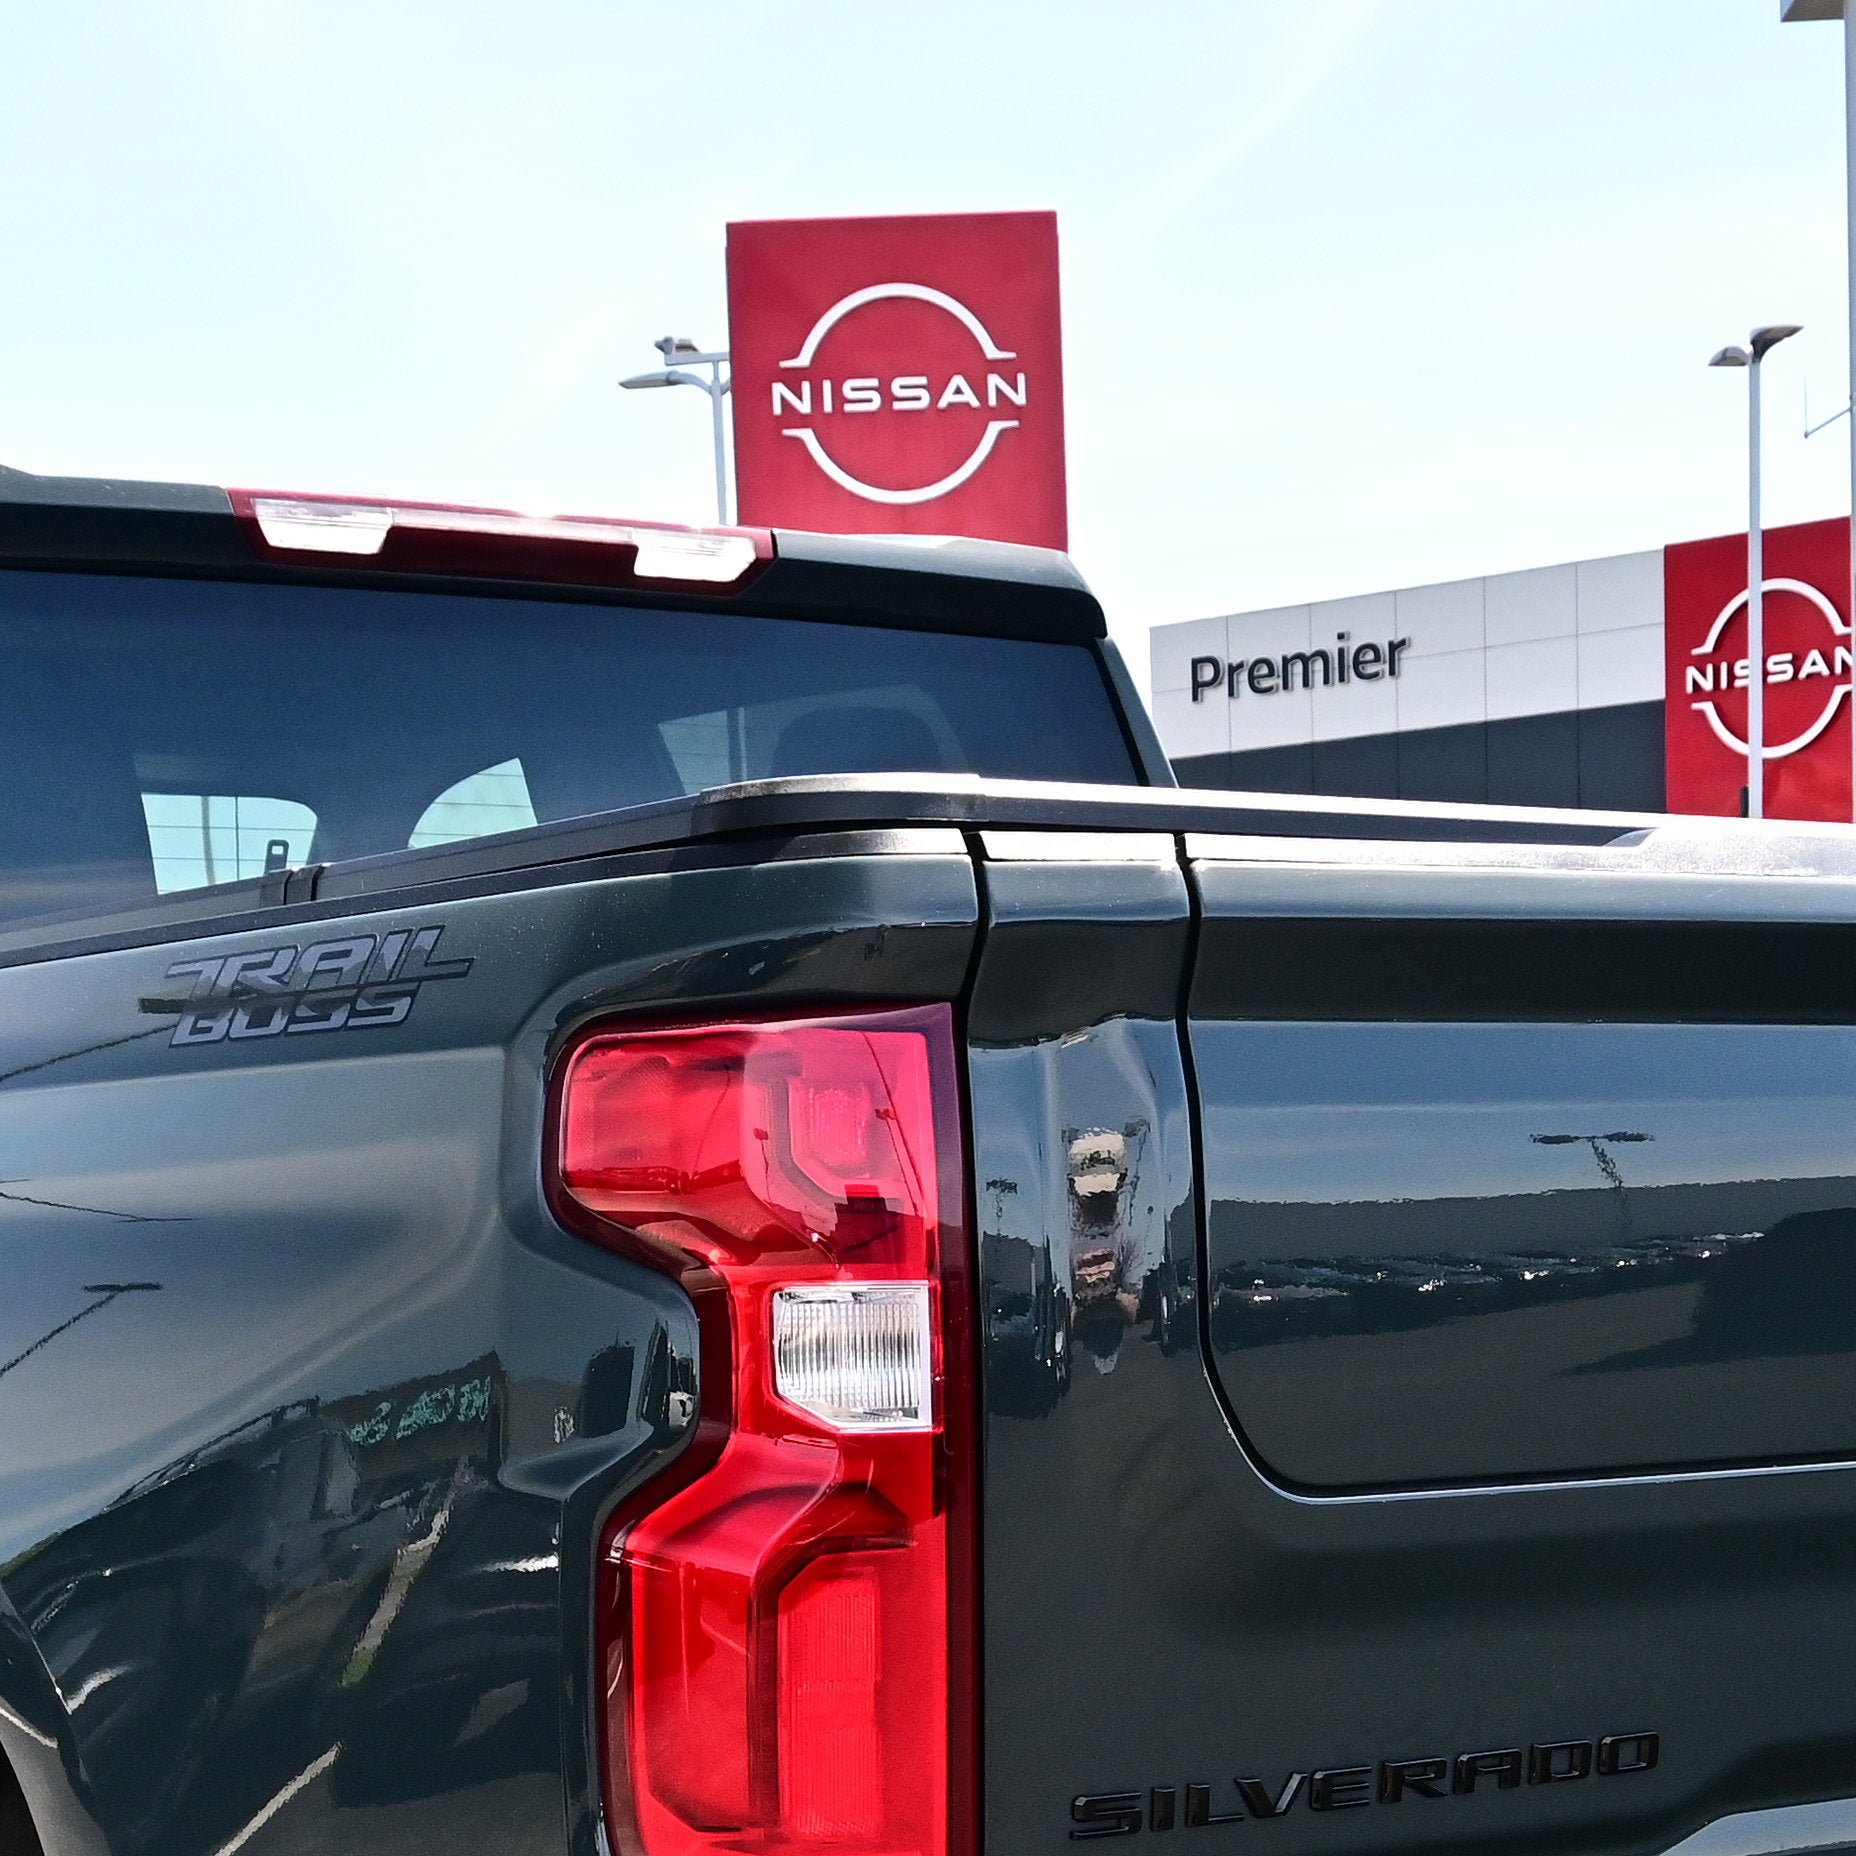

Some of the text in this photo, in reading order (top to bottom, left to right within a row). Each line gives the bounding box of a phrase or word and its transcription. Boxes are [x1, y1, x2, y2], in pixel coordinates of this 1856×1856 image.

[771, 371, 1028, 416] NISSAN
[1190, 630, 1411, 703] Premier
[166, 924, 475, 1000] TRAIL
[160, 981, 422, 1048] BOSS
[1068, 1731, 1661, 1841] SILVERADO
